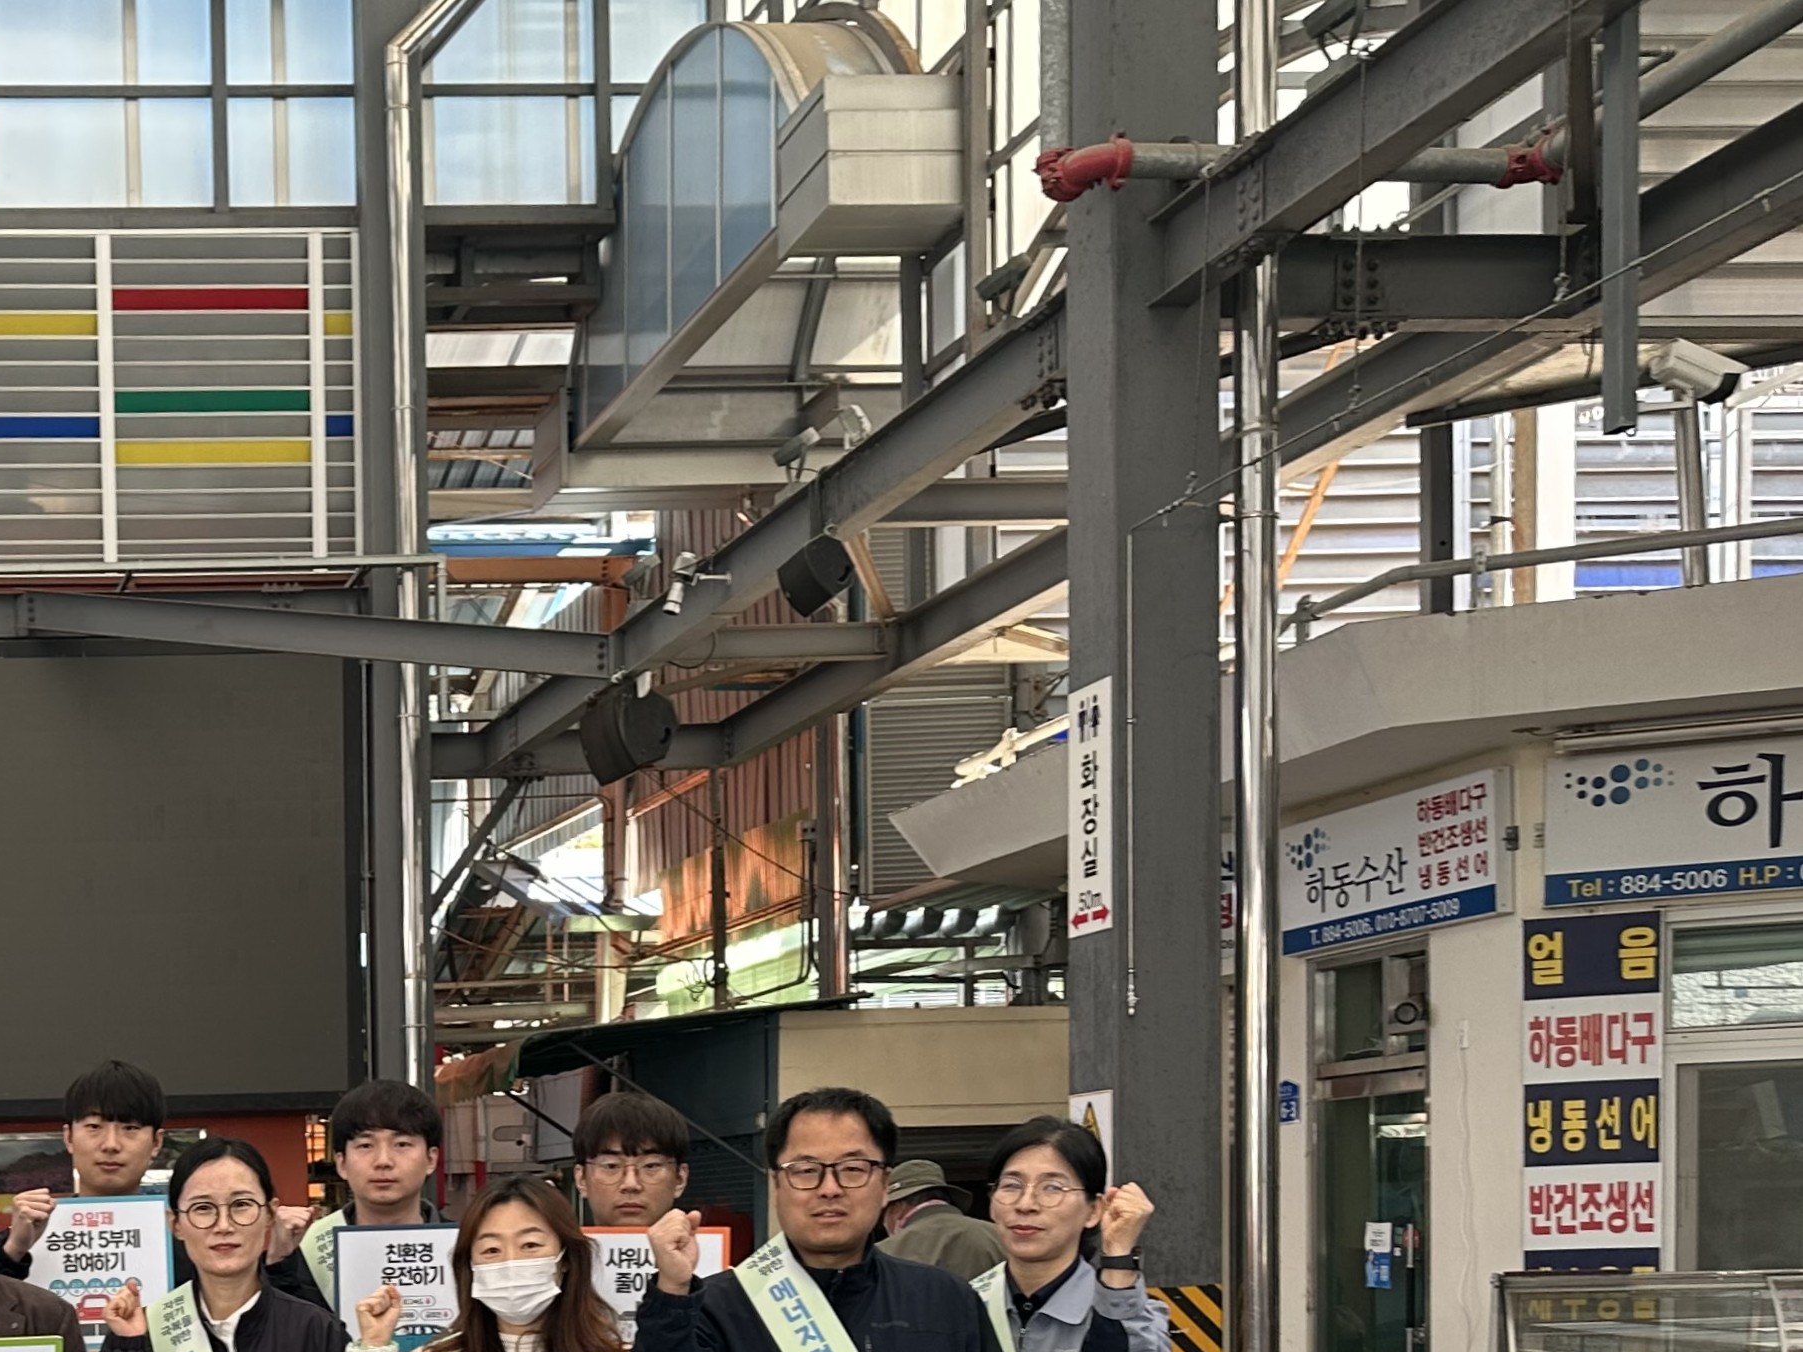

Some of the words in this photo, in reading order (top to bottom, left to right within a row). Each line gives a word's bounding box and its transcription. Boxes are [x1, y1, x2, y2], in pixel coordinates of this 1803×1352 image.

[1081, 751, 1099, 878] 화장실
[1417, 783, 1487, 823] 하동배다구
[1418, 816, 1488, 857] 반건조생선
[1305, 847, 1408, 913] 하동수산
[1418, 851, 1489, 890] 냉동선어
[1620, 869, 1727, 895] 884-5006
[1078, 891, 1102, 911] 50m
[1527, 926, 1658, 986] 얼음
[1529, 1012, 1656, 1069] 하동배다구
[1527, 1095, 1657, 1153] 냉동선어
[72, 1211, 113, 1227] 요일제
[1529, 1181, 1654, 1236] 반건조생선
[46, 1229, 95, 1252] 승용차
[98, 1228, 141, 1250] 5부제
[385, 1242, 434, 1264] 친환경
[61, 1251, 127, 1274] 참여하기
[381, 1266, 445, 1286] 운전하기
